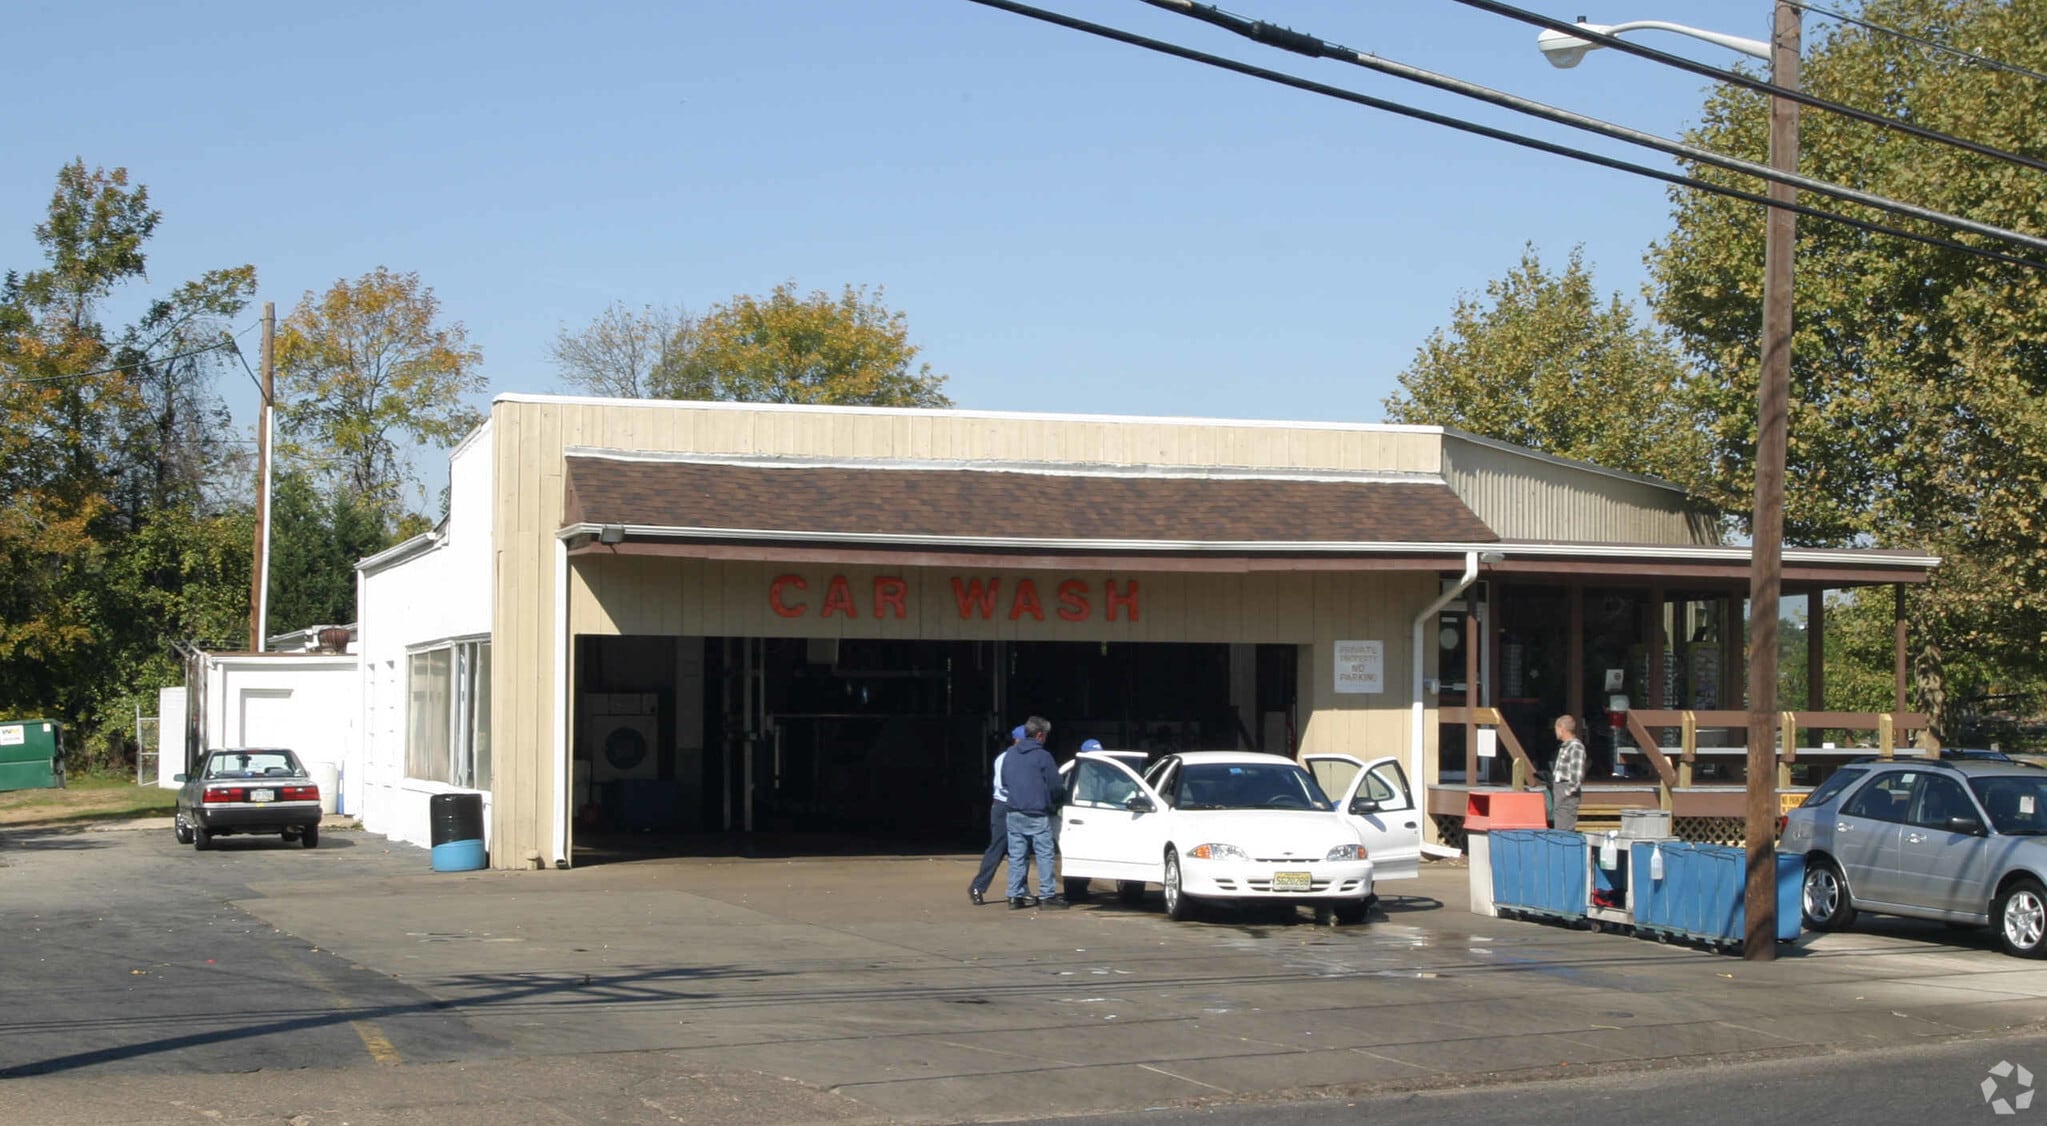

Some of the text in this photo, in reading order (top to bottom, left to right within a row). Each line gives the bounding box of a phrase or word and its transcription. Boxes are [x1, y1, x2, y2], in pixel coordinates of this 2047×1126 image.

[768, 573, 1141, 622] CAR WASH
[1339, 646, 1378, 655] PRIVATE
[1339, 655, 1379, 664] PROPERTY
[1351, 664, 1365, 673] NO
[1339, 673, 1377, 682] PARKING
